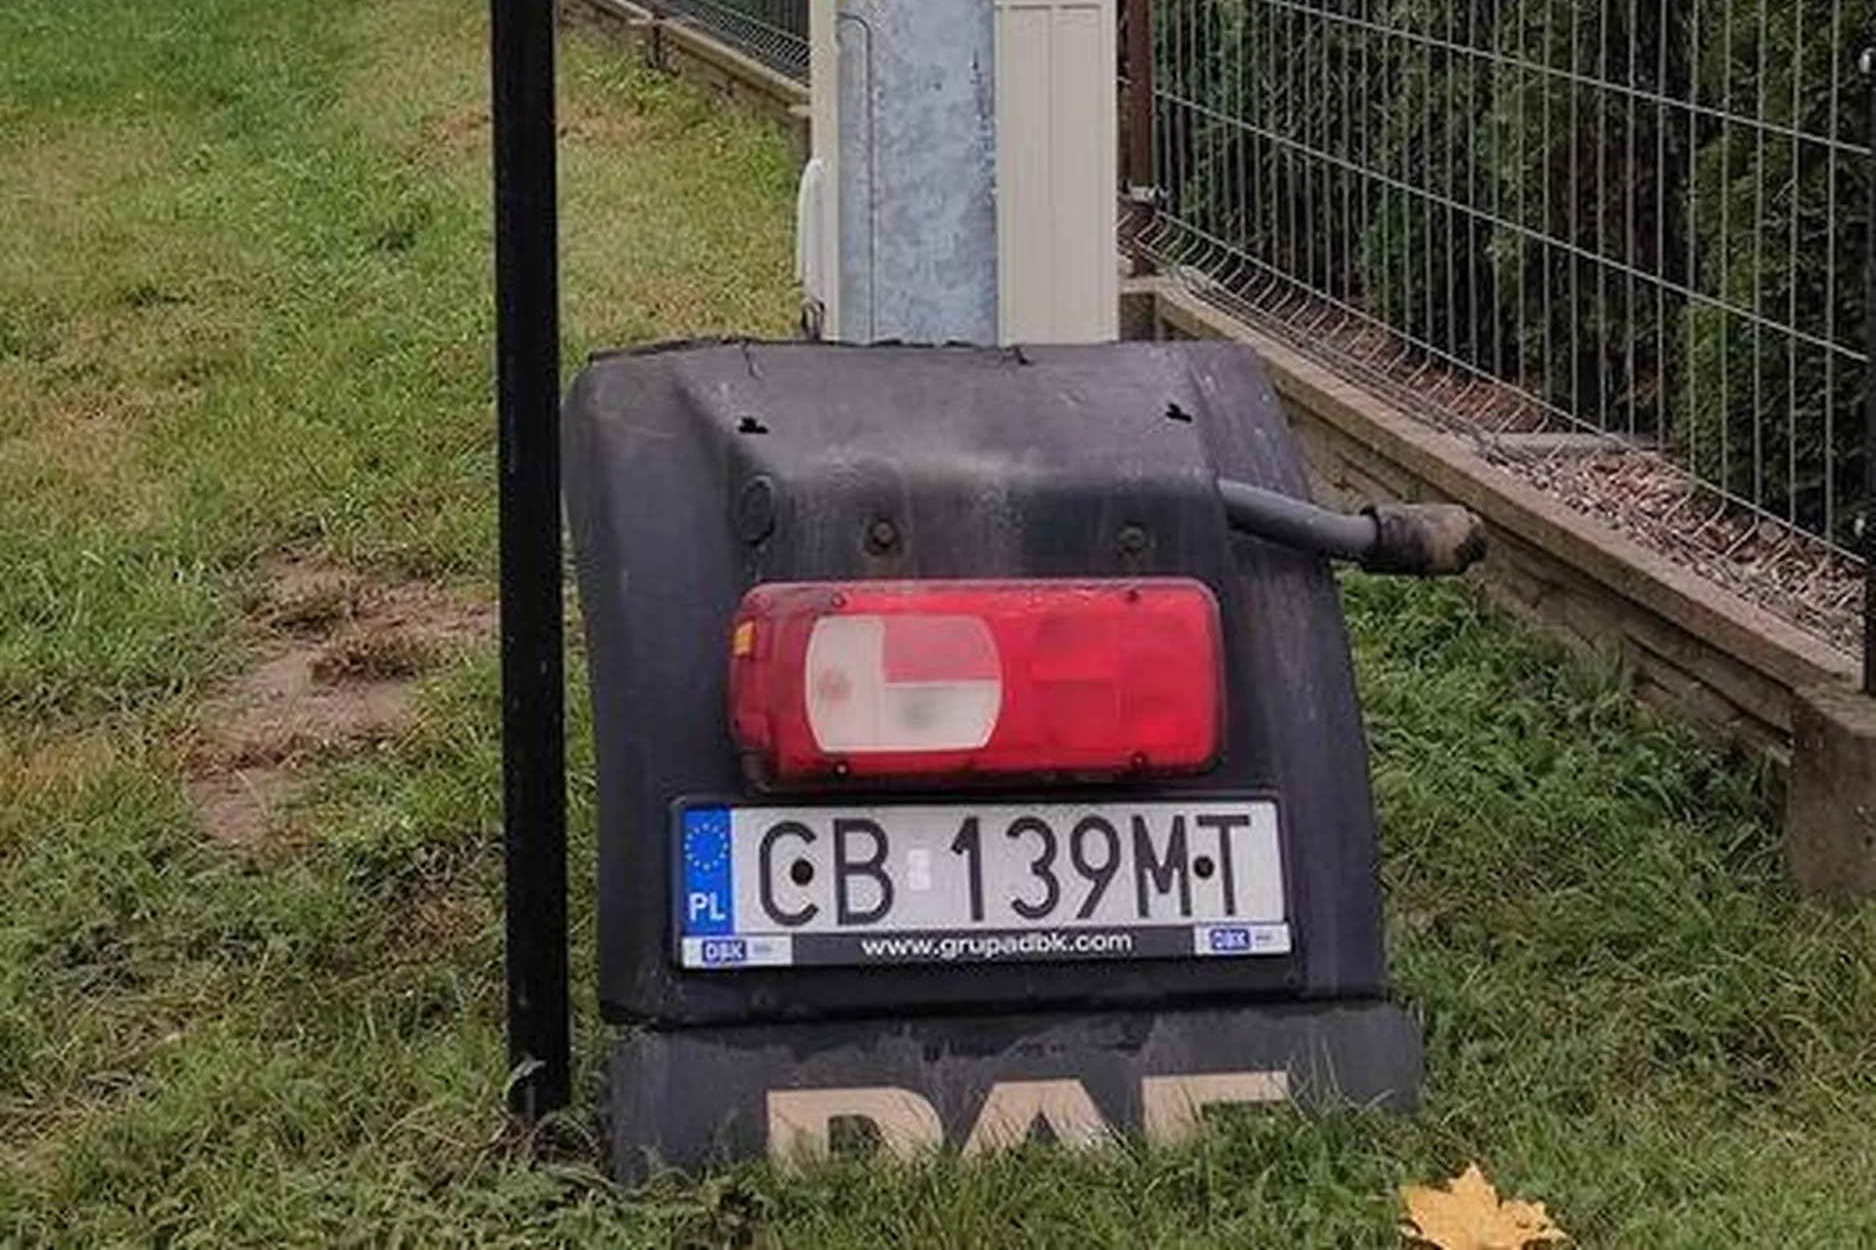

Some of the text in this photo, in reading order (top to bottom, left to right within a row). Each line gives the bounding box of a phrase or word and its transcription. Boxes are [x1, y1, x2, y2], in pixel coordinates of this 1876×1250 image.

[759, 814, 1250, 927] CB 139MT
[689, 892, 726, 922] PL
[861, 932, 1133, 960] www.grupadbk.com
